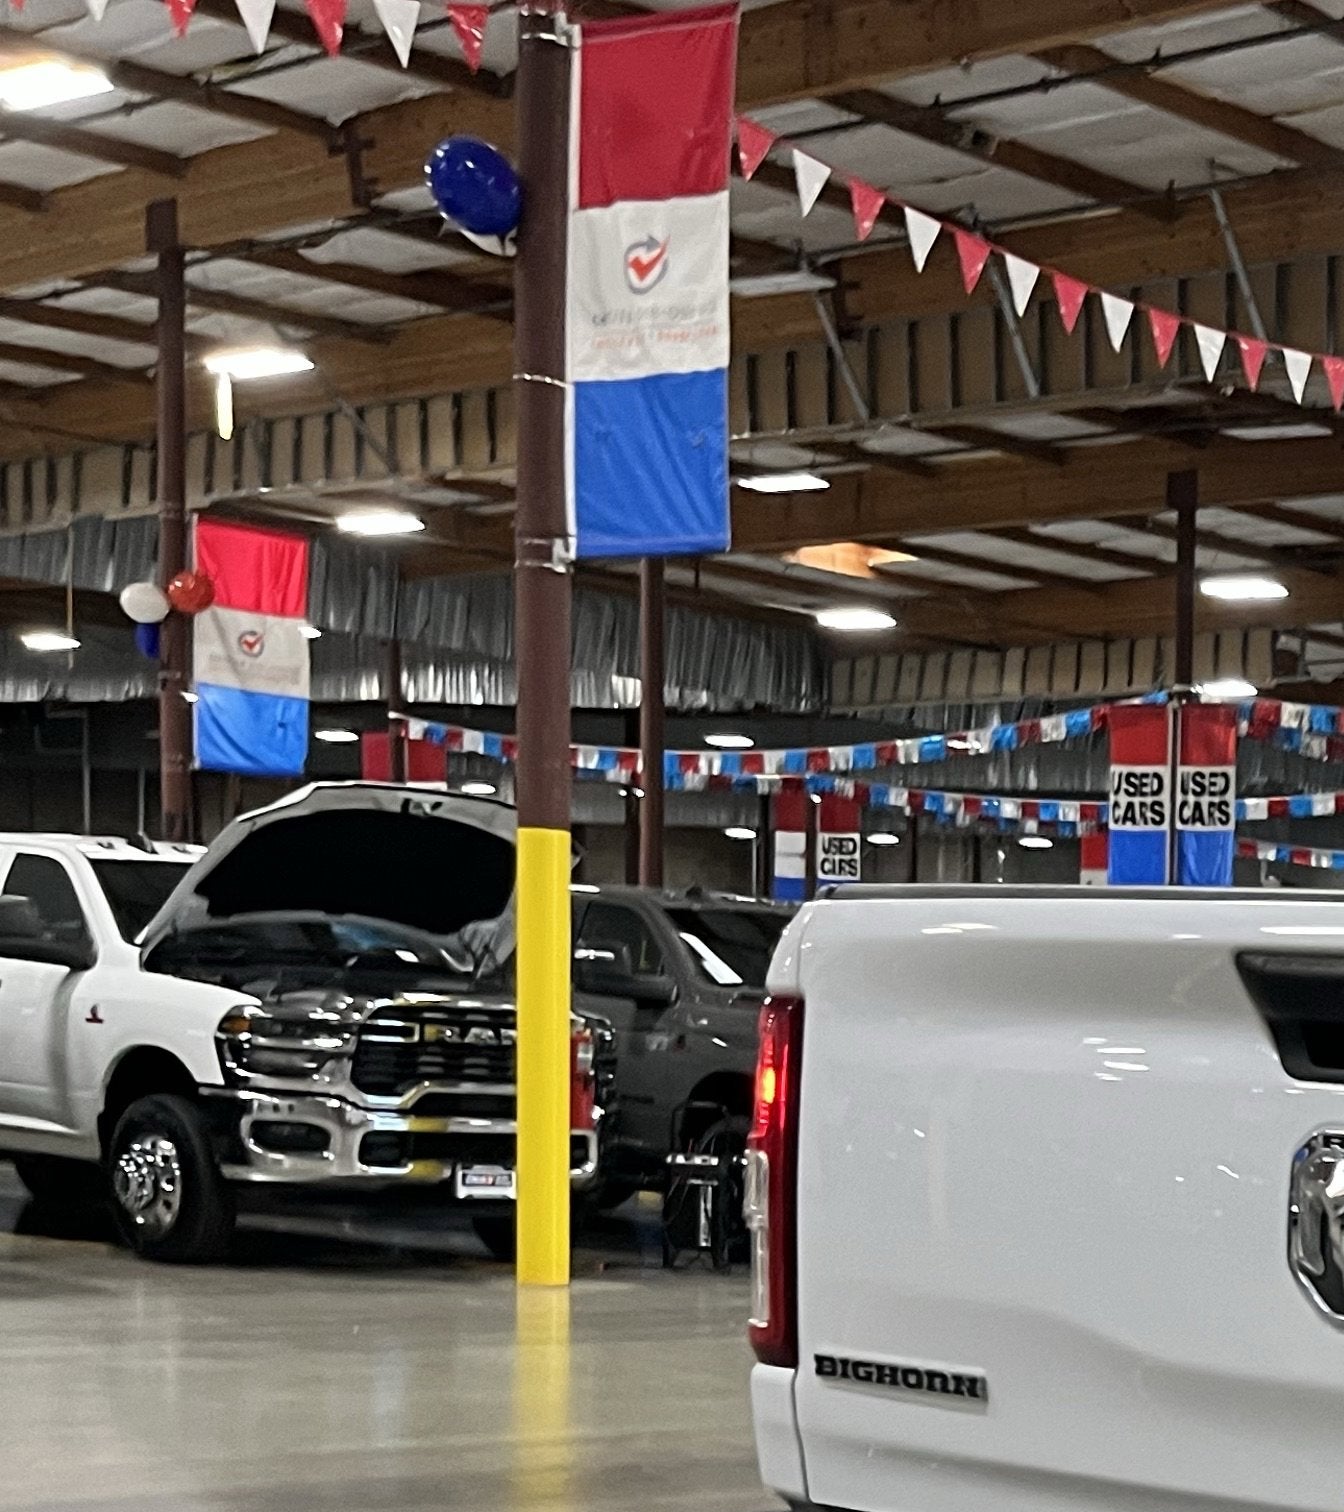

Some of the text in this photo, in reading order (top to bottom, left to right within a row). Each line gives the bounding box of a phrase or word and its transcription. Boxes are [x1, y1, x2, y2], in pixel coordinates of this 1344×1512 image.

[1112, 771, 1164, 797] USED
[1180, 771, 1230, 797] USED
[1112, 800, 1165, 826] CARS
[1178, 800, 1230, 826] CARS
[822, 836, 857, 855] USED
[821, 857, 858, 876] CARS
[814, 1353, 982, 1399] BIGHORN
